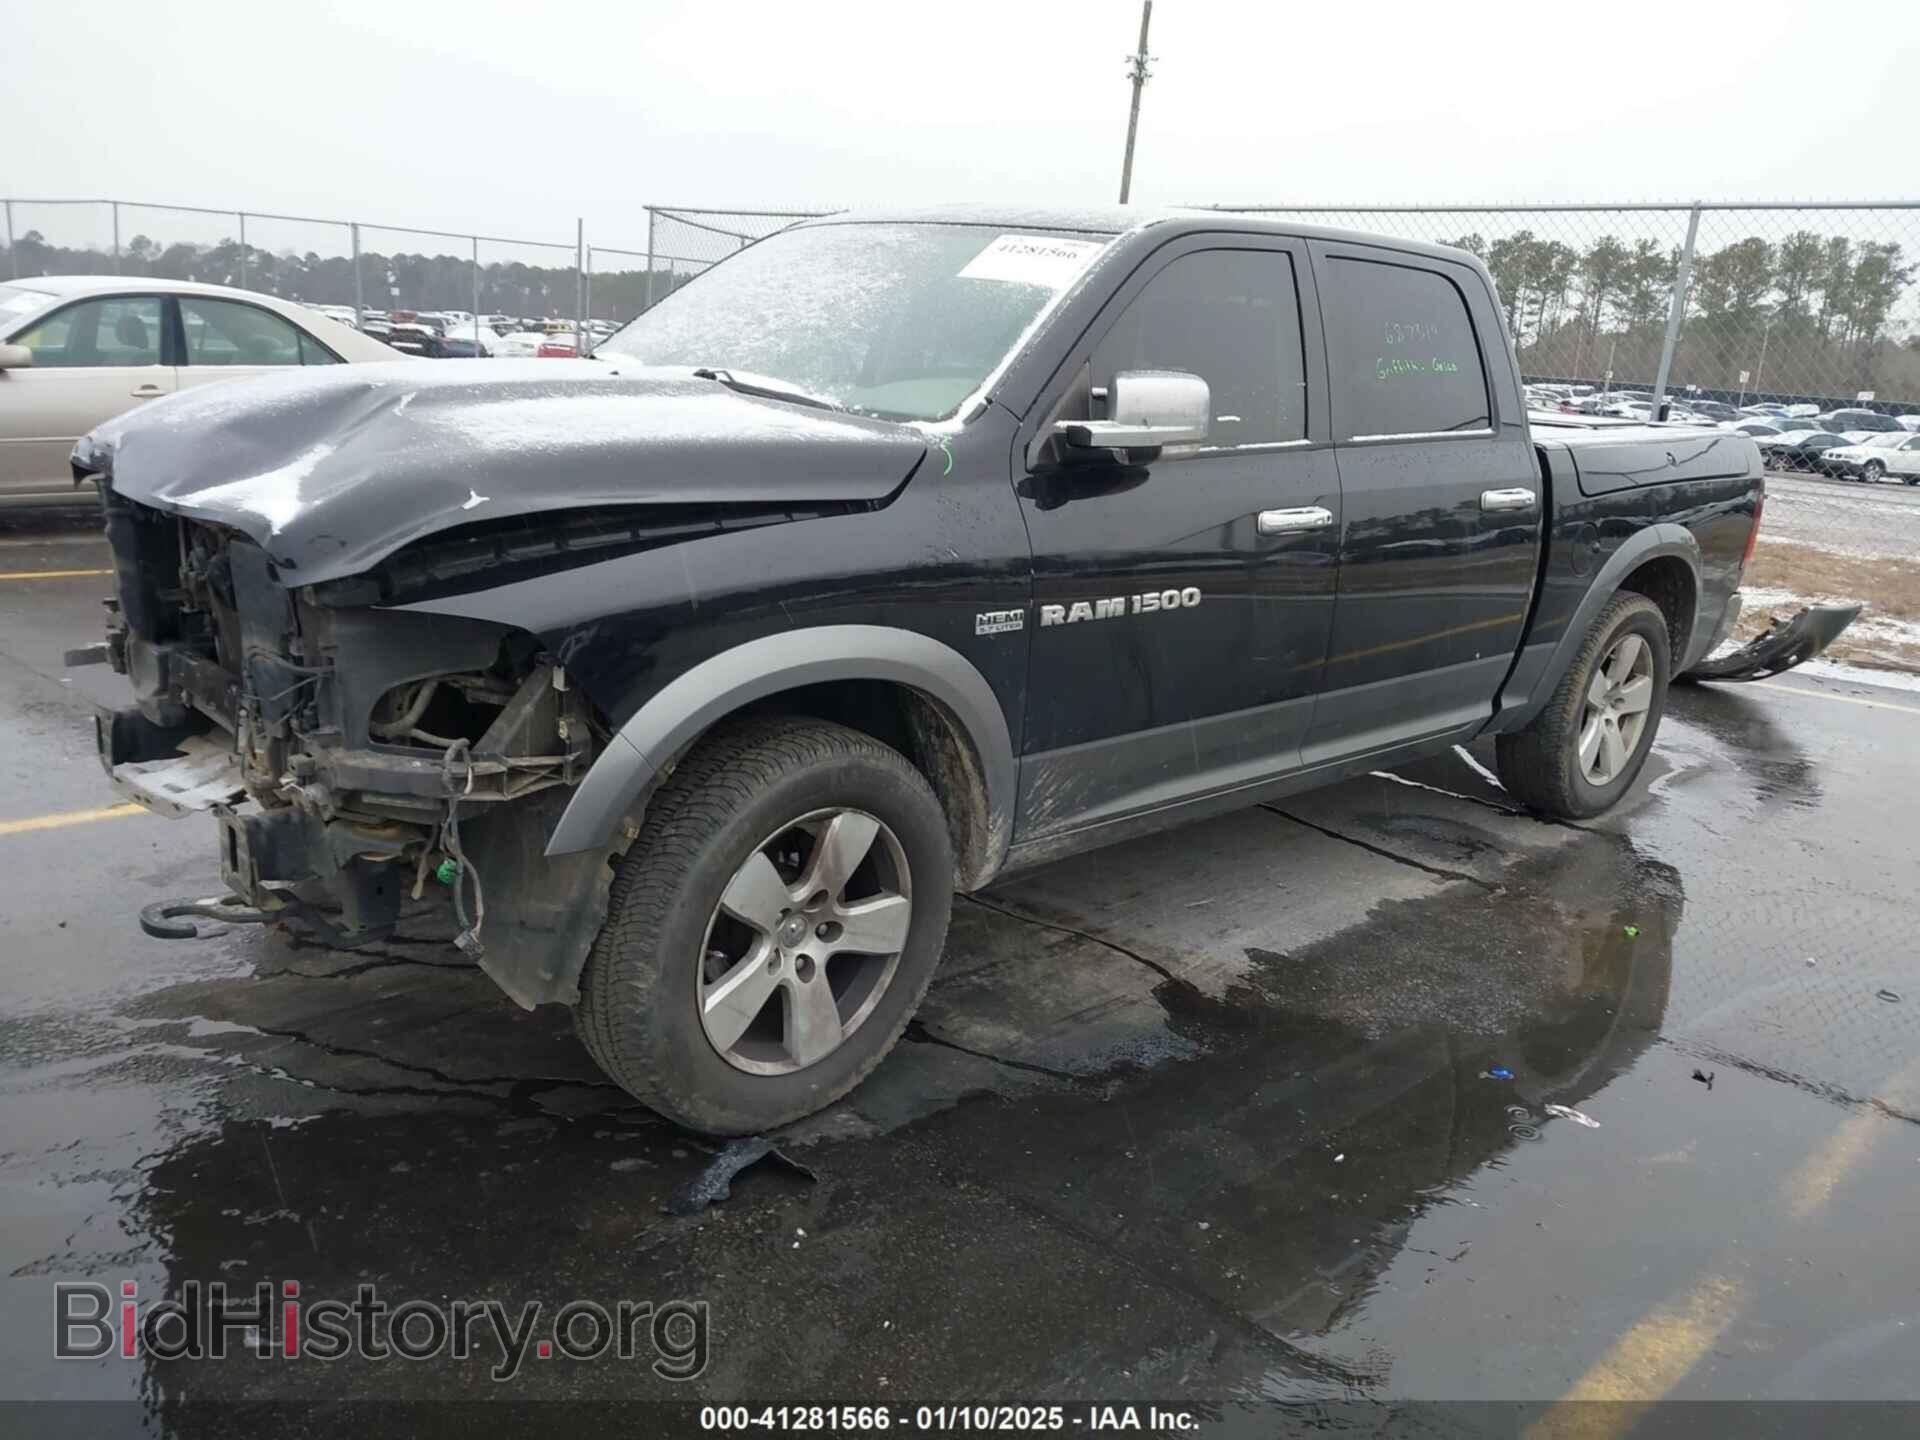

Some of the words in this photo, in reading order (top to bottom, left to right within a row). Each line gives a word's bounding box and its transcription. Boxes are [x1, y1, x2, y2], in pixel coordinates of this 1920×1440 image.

[976, 608, 1025, 625] HEMI
[1040, 597, 1126, 628] RAM
[1130, 587, 1202, 615] 1500
